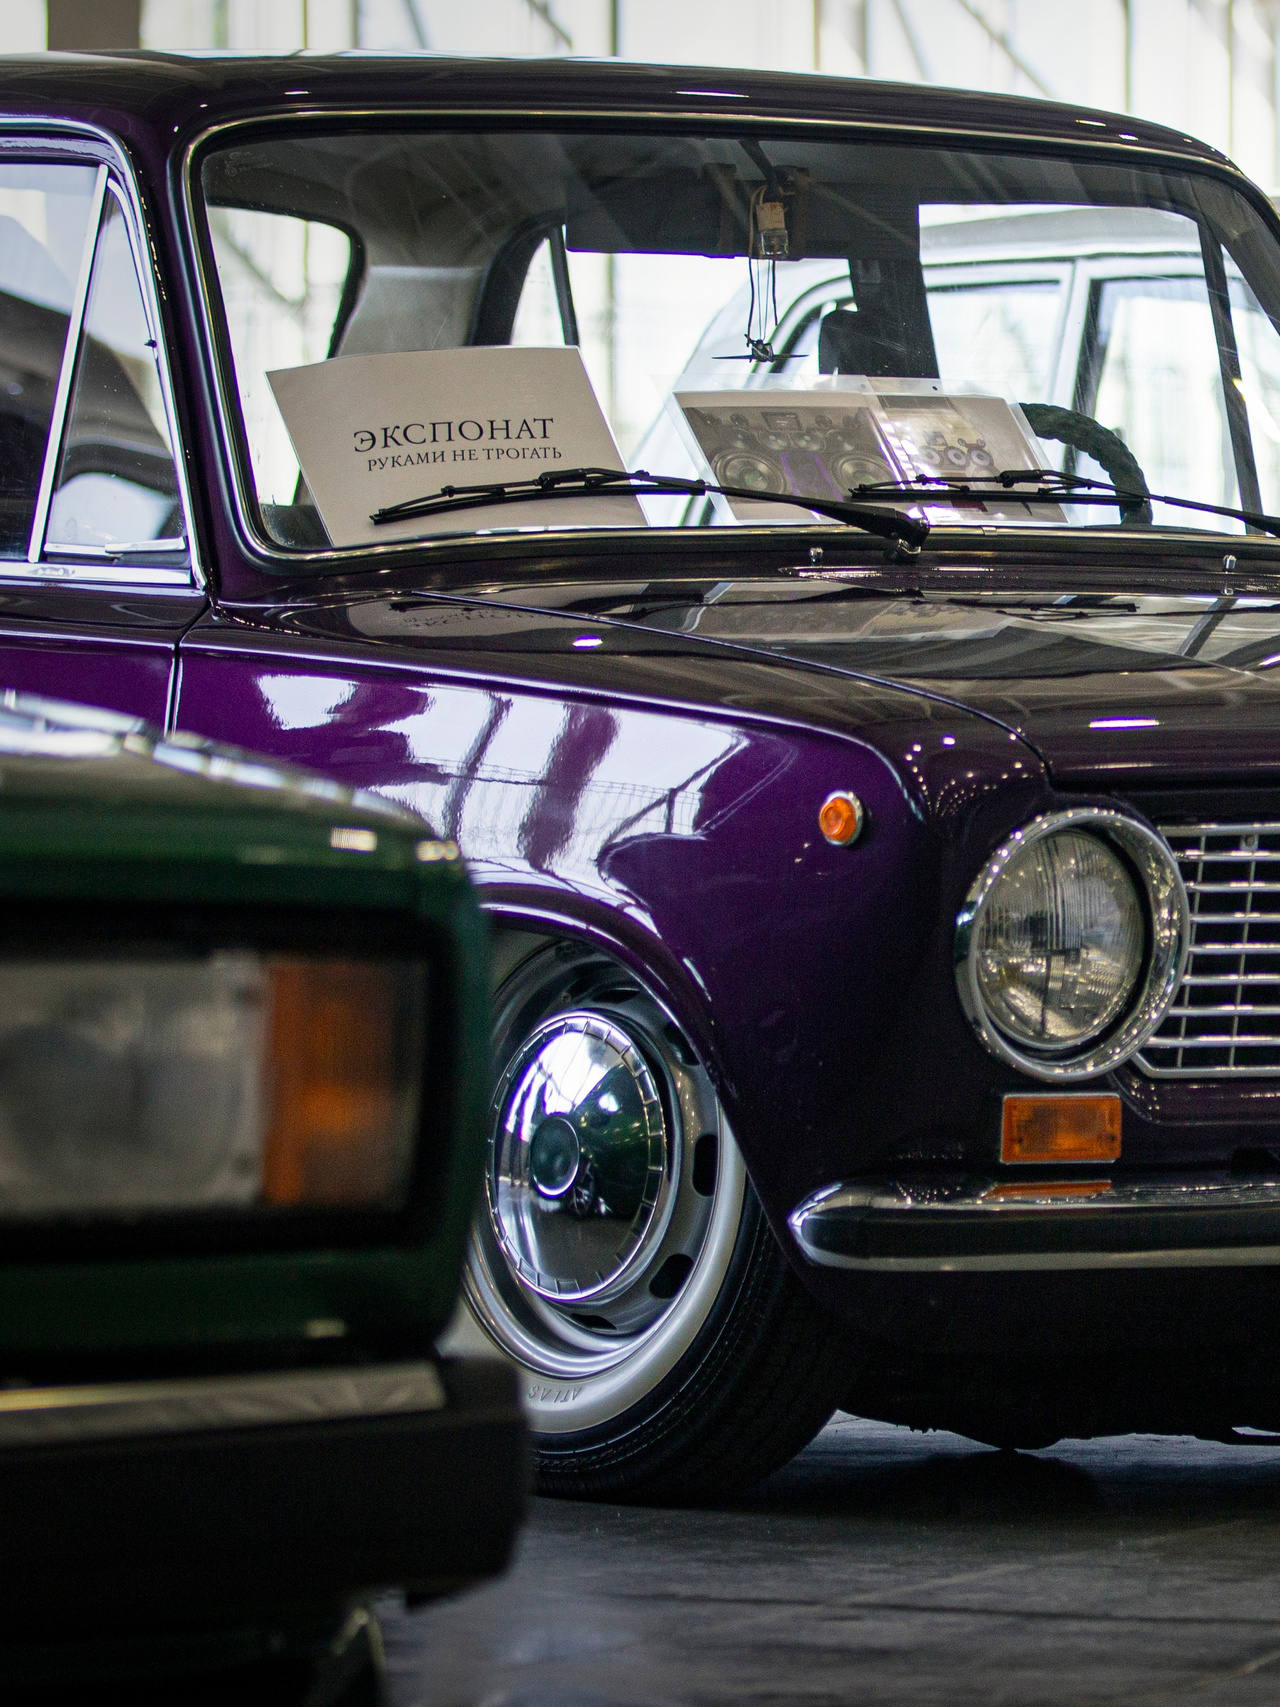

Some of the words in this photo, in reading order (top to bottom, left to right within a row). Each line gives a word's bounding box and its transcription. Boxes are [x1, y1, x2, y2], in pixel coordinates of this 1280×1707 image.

[353, 417, 554, 452] ЭКСПОНАТ
[367, 451, 446, 472] РУКАМИ
[452, 449, 479, 462] НЕ
[482, 447, 562, 461] ТРОГАТЬ
[528, 1385, 584, 1404] ATLAS
